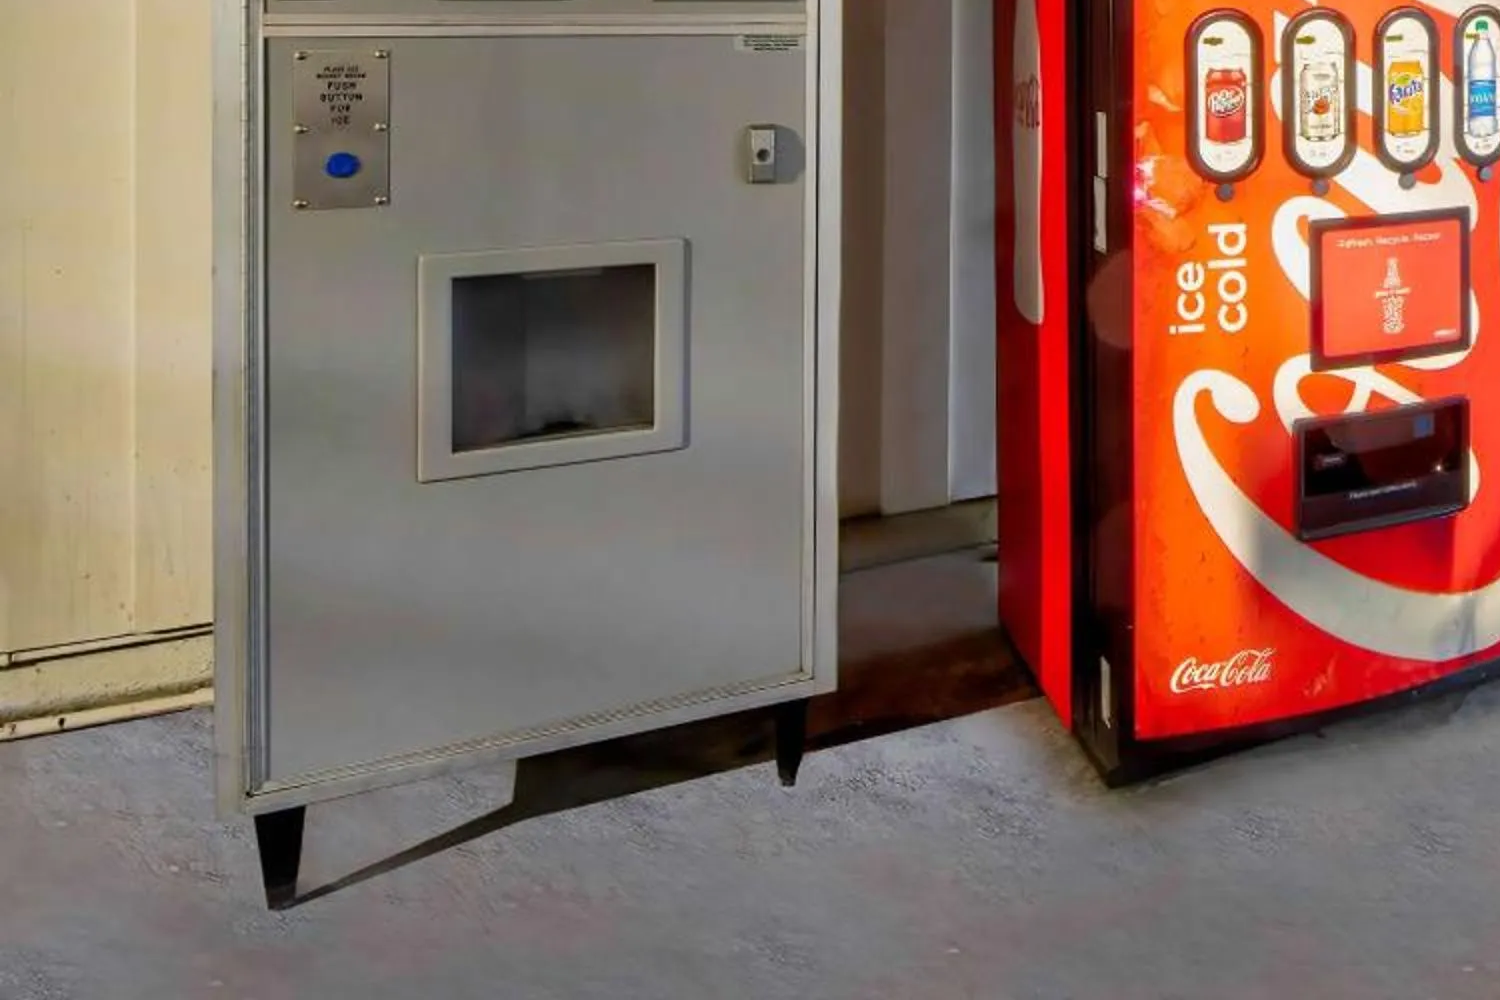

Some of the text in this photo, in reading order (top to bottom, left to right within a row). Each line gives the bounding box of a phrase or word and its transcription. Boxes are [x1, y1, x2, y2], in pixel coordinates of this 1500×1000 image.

[319, 93, 363, 102] BUTTON
[327, 81, 357, 91] PUSH
[1169, 261, 1205, 335] ice
[1208, 223, 1248, 333] cold
